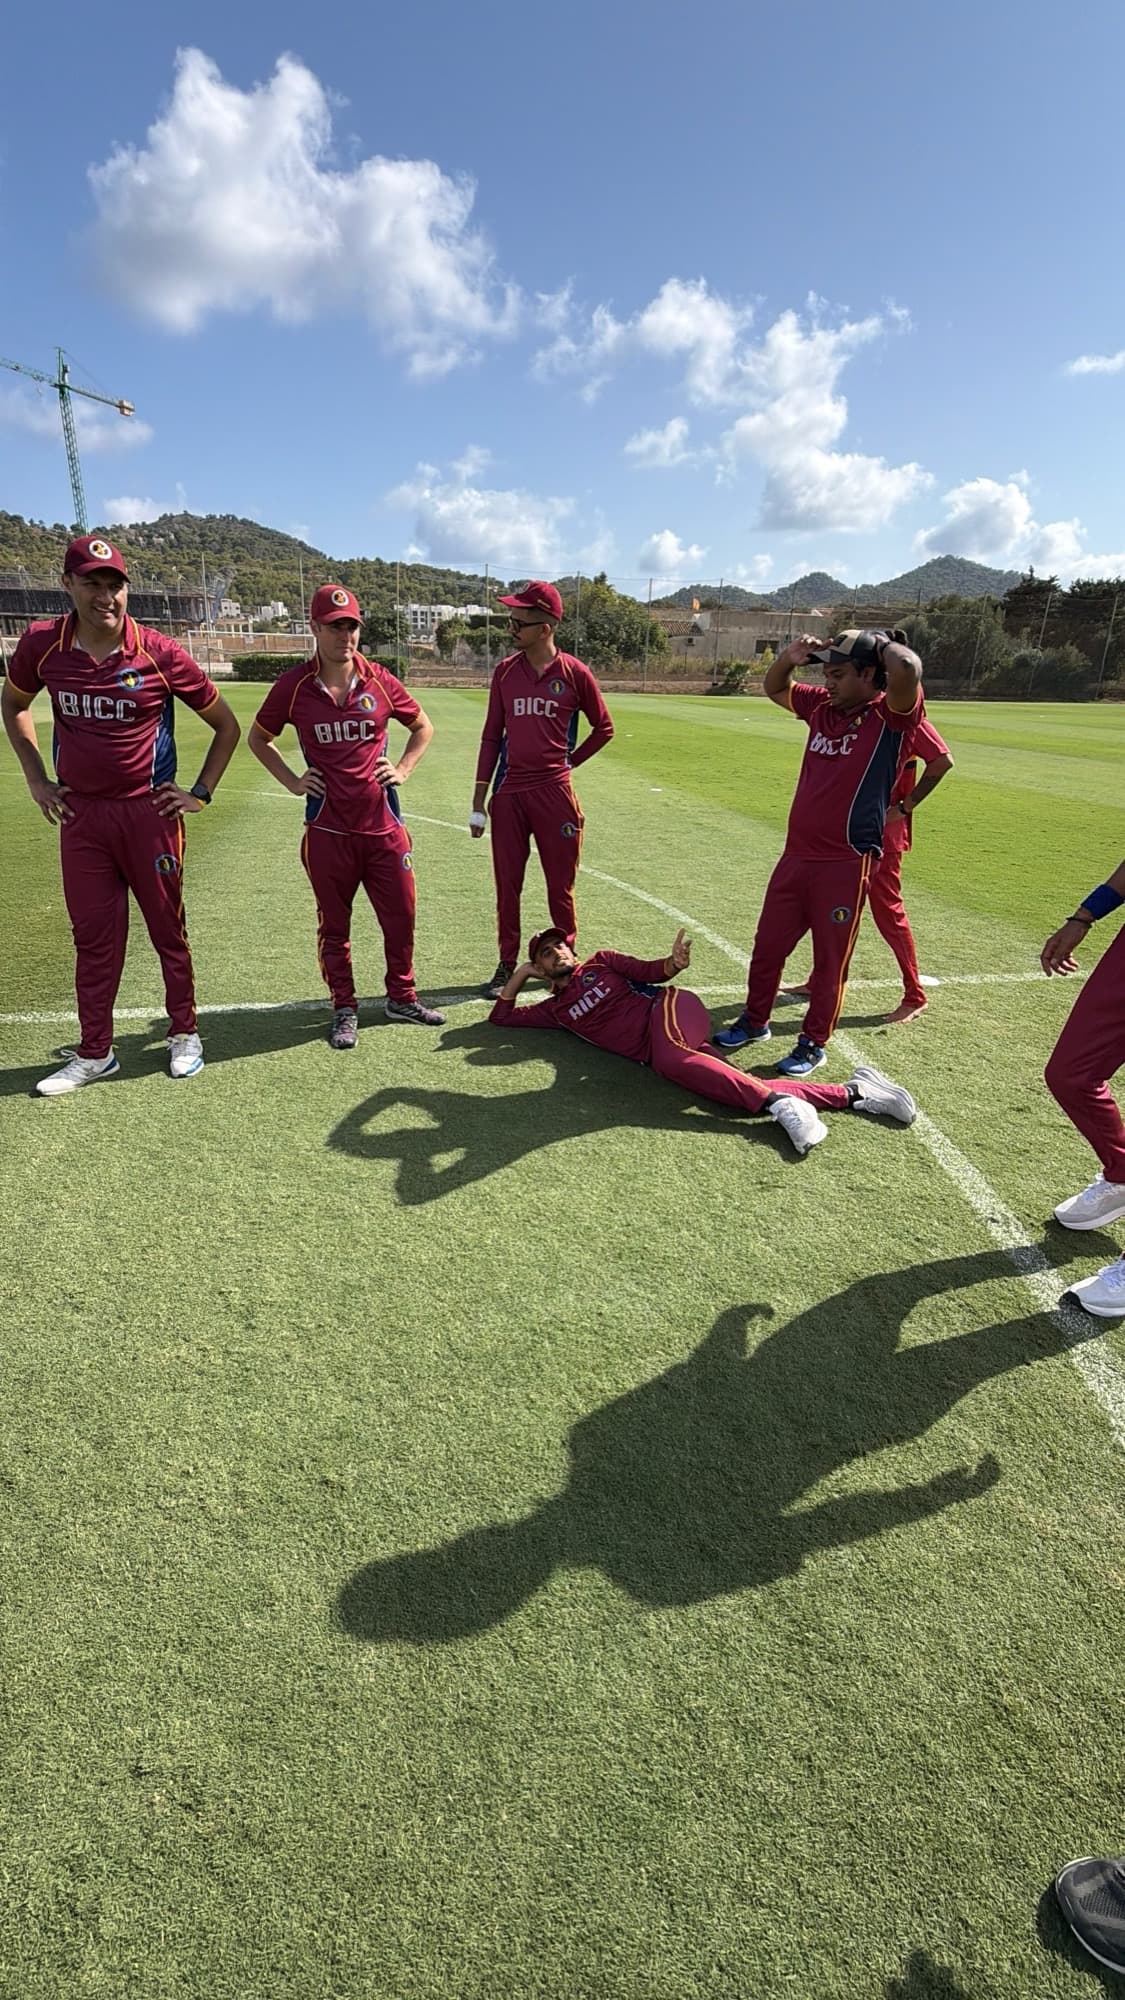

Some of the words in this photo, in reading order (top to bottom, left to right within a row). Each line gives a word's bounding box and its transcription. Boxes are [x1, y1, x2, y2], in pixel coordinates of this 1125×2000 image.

[58, 691, 137, 722] BICC
[513, 697, 559, 718] BICC
[314, 720, 376, 744] BICC
